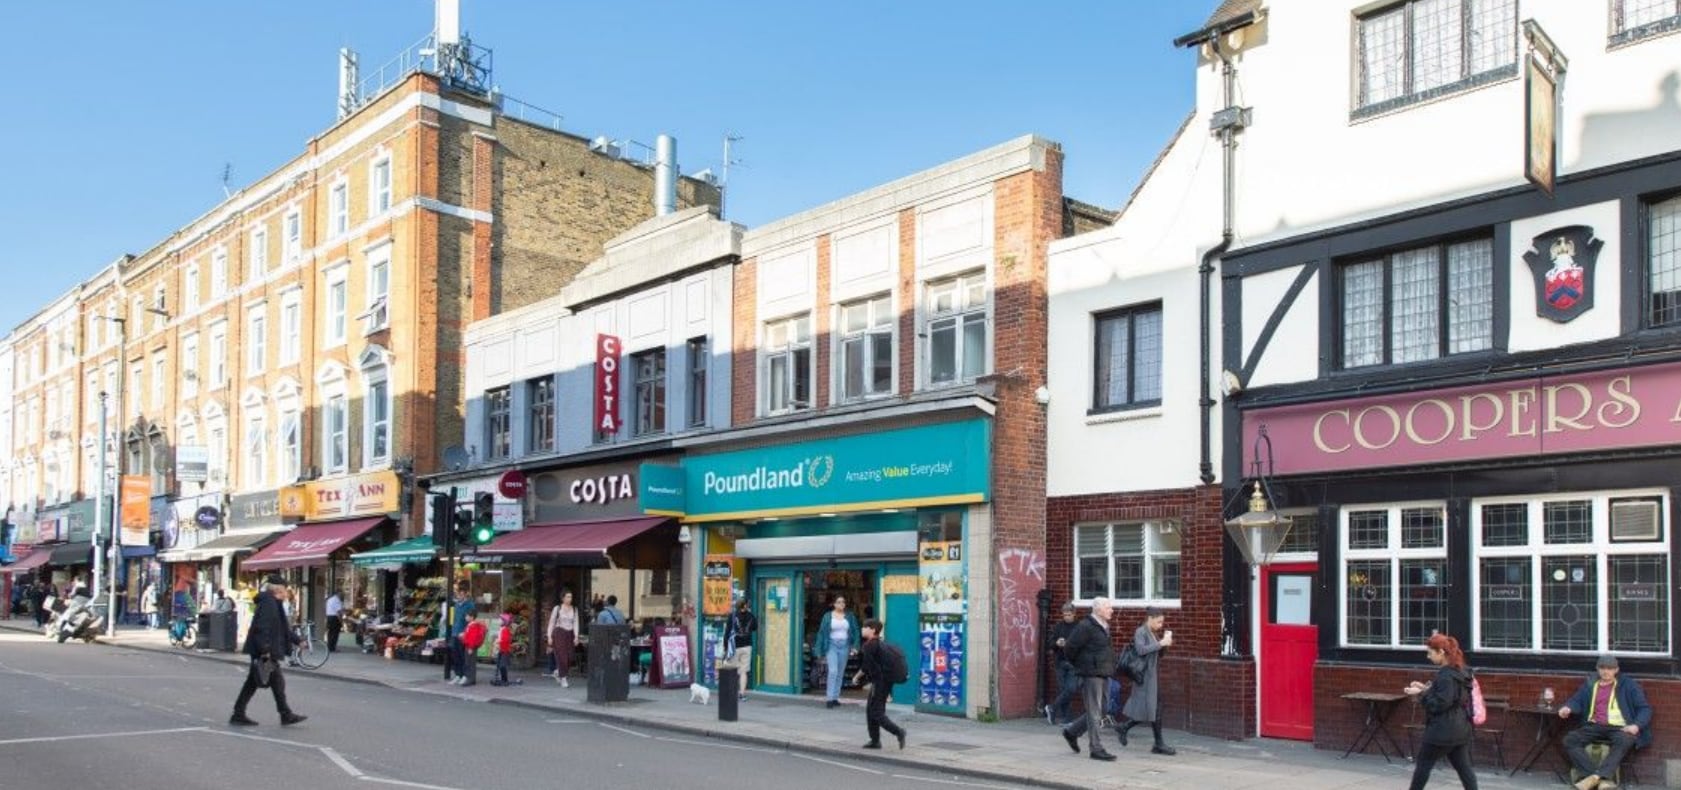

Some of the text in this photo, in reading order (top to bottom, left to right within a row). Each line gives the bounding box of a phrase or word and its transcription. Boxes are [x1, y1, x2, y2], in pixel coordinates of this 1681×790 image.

[602, 338, 616, 429] COSTA
[1313, 375, 1642, 453] COOPERS
[704, 461, 804, 495] Poundland
[845, 460, 953, 482] Amazing Value Everyday!
[317, 489, 341, 502] TEX
[570, 474, 633, 504] COSTA
